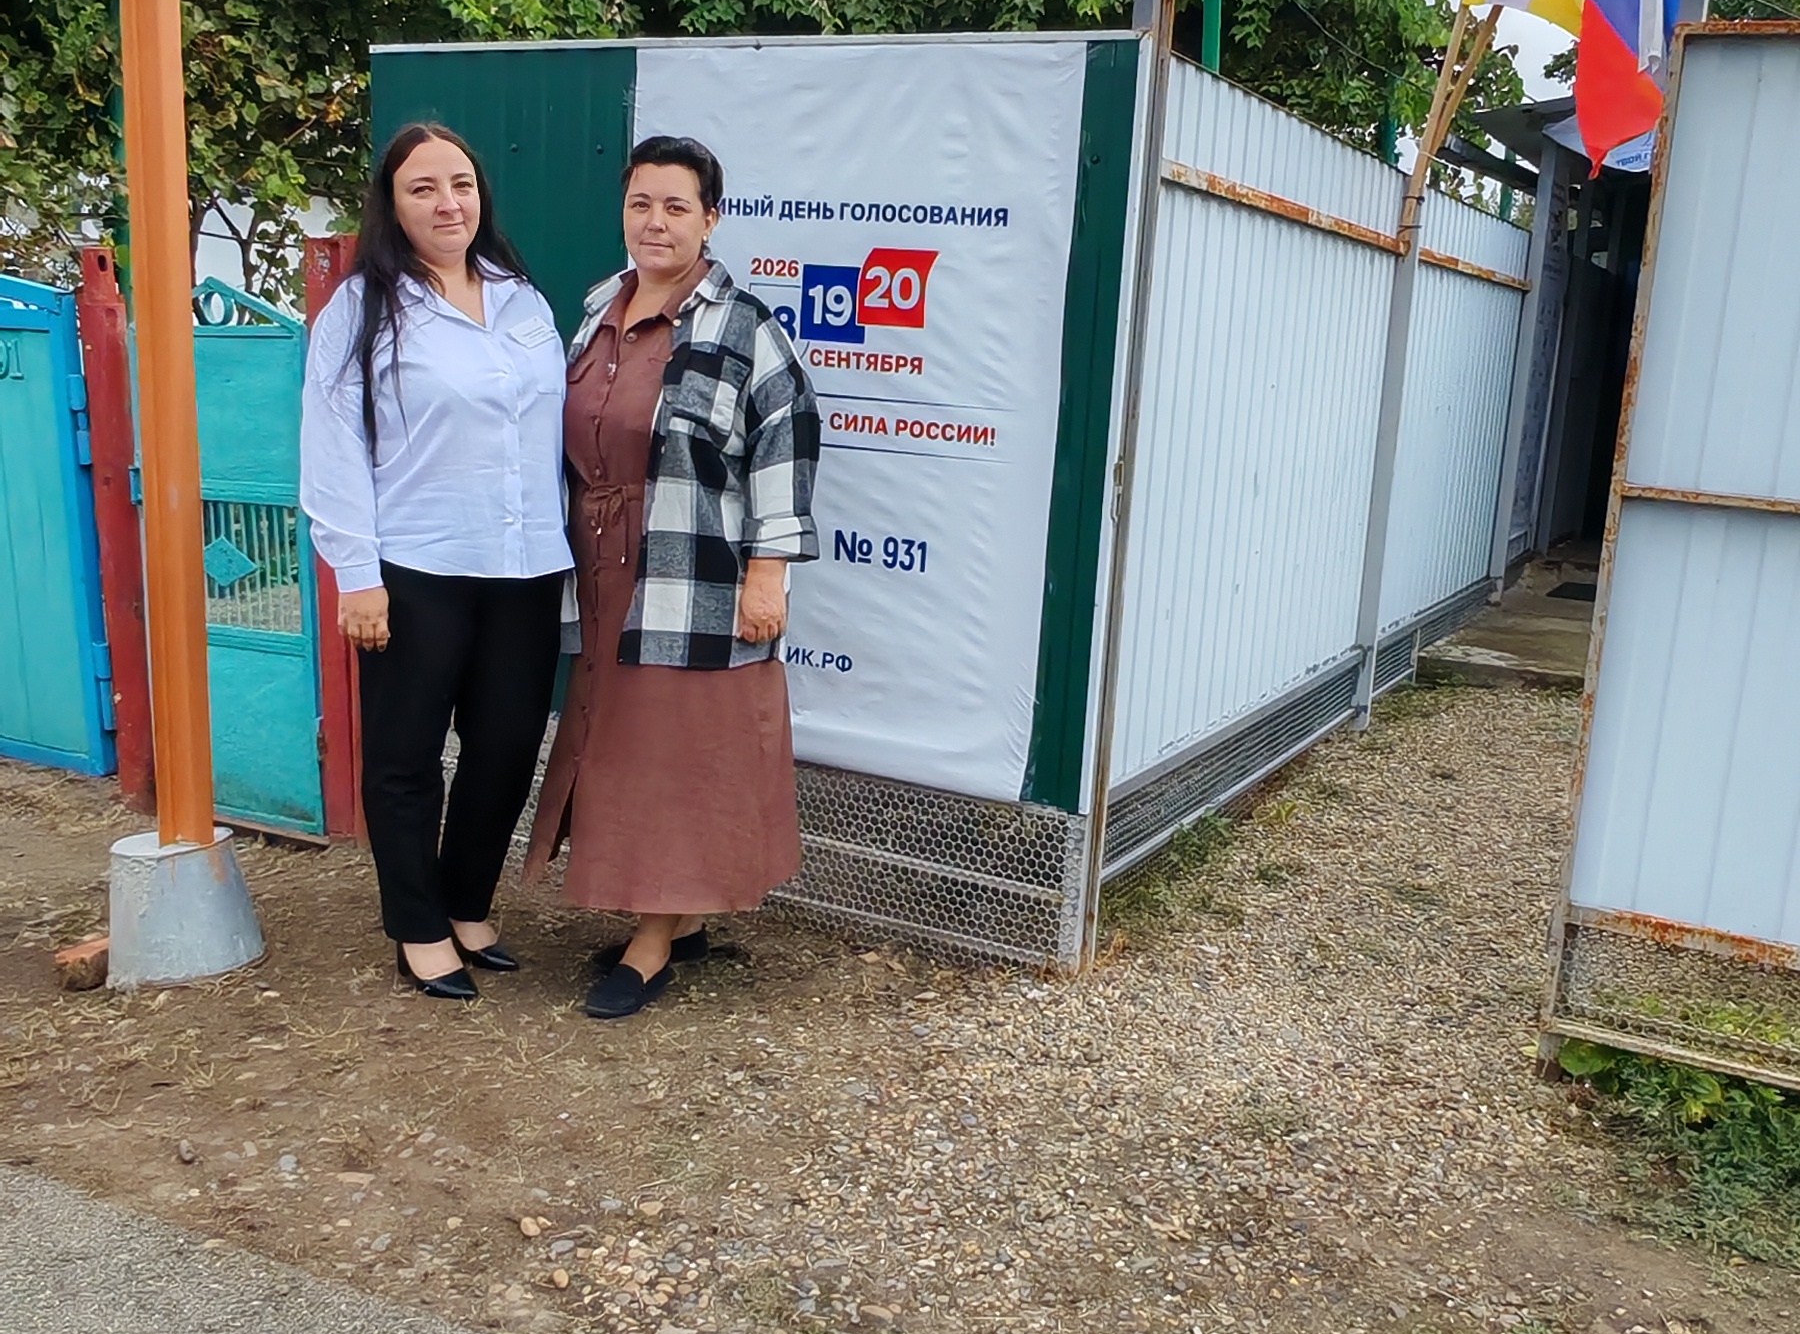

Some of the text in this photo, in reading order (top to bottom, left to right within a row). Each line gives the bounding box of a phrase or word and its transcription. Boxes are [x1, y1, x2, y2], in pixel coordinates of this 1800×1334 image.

[779, 200, 834, 221] ДЕНЬ
[840, 202, 1008, 227] ГОЛОСОВАНИЯ
[750, 258, 799, 277] 2026
[773, 266, 921, 343] 8 19 20
[810, 349, 923, 375] СЕНТЯБРЯ
[829, 412, 996, 447] СИЛА РОССИИ!
[834, 529, 927, 573] № 931
[786, 646, 853, 673] ИК.РФ
